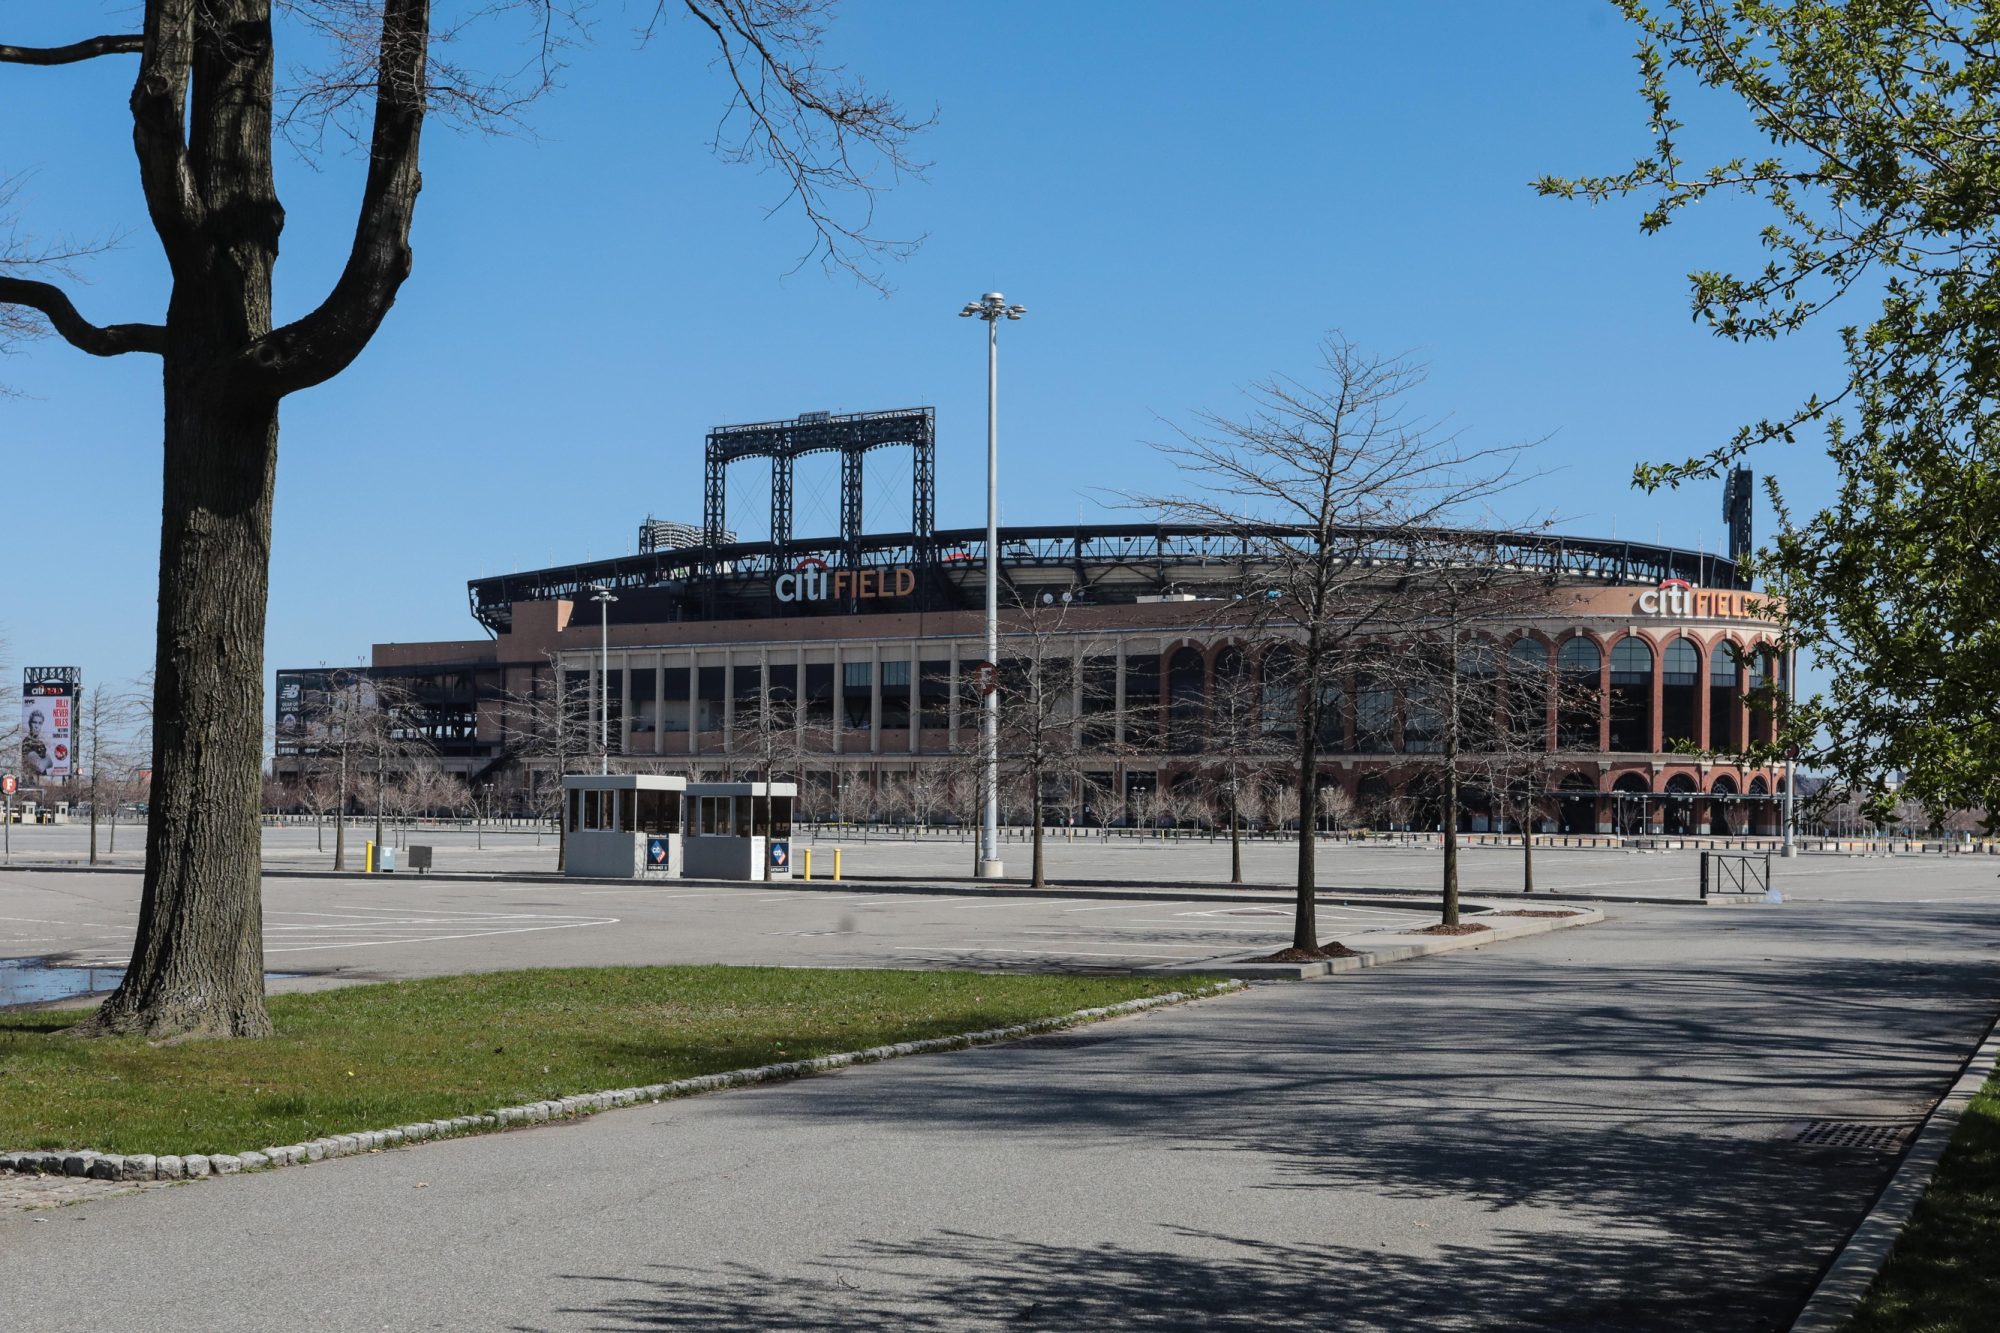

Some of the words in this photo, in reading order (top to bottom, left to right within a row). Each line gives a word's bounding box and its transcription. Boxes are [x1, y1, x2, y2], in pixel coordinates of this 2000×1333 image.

[775, 558, 828, 602] citi
[834, 568, 916, 599] FIELD
[1639, 578, 1691, 614] citi
[53, 708, 68, 717] NEVER
[6, 778, 13, 791] F
